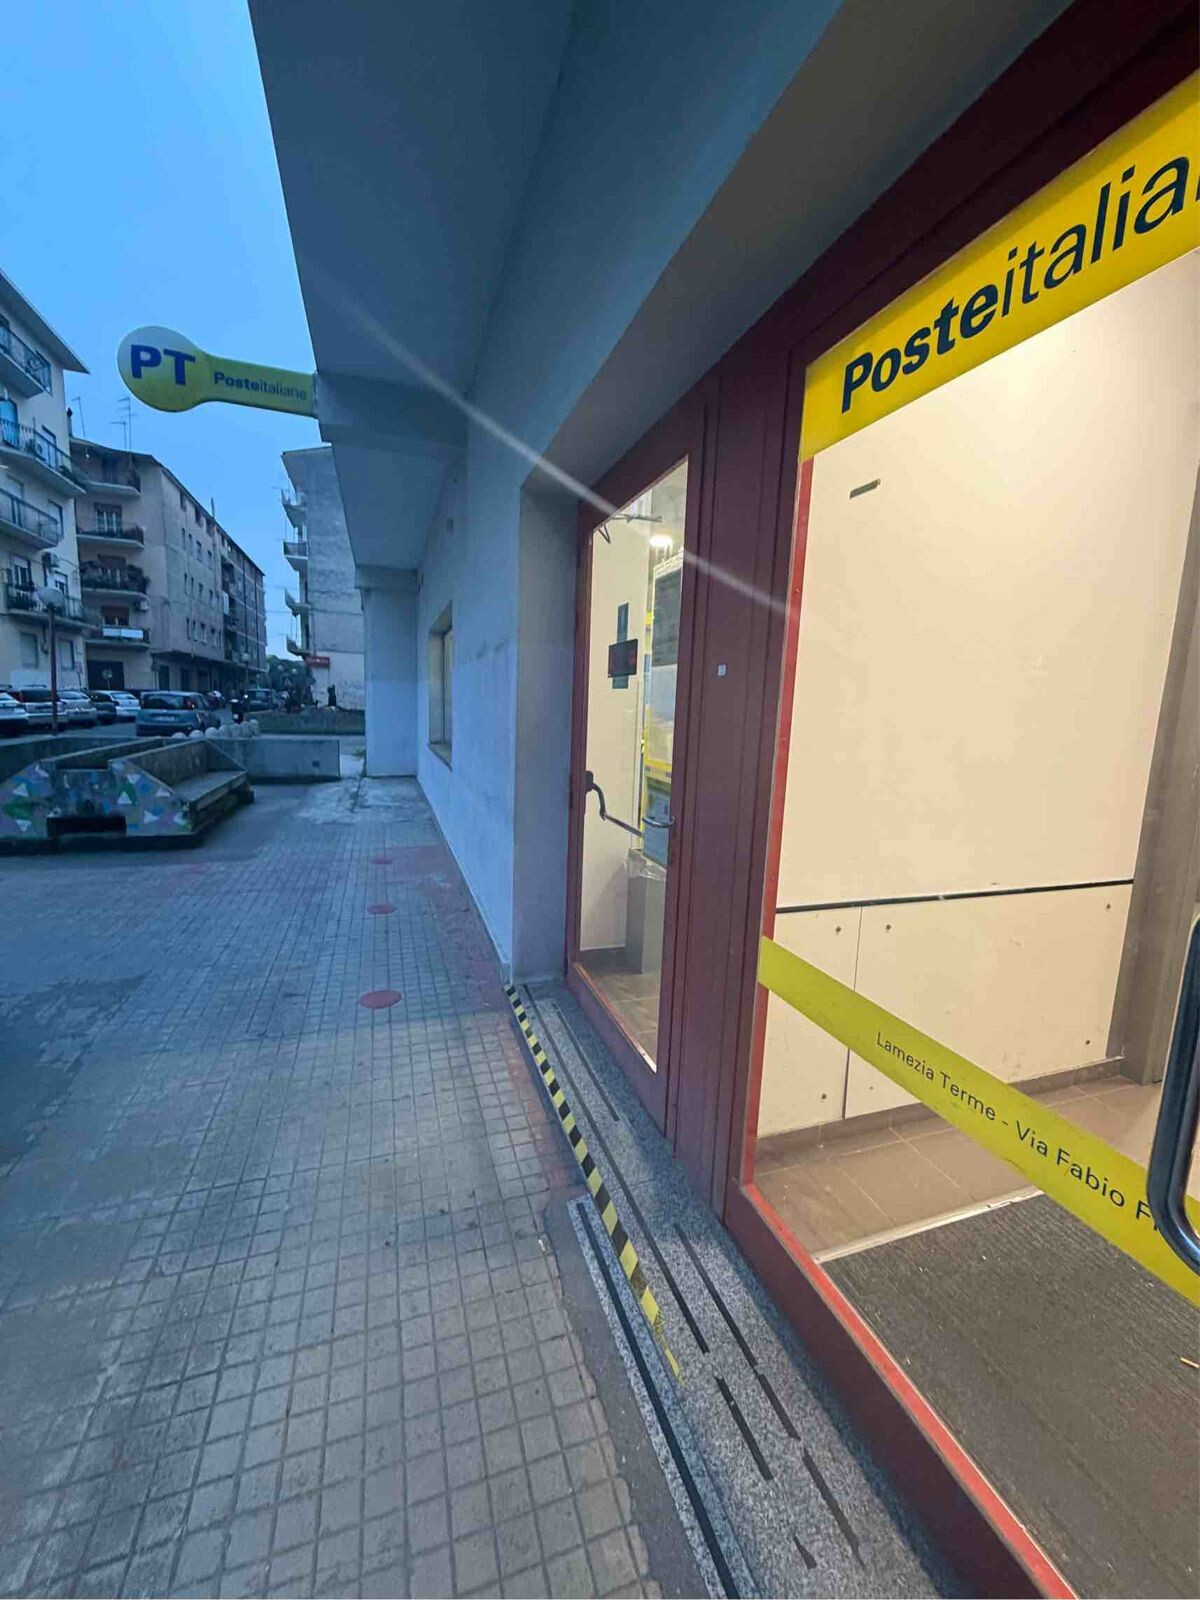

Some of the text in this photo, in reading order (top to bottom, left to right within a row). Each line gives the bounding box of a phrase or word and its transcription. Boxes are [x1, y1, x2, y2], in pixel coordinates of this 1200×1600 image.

[841, 156, 1200, 414] Posteitalia
[130, 344, 196, 386] PT
[213, 371, 308, 400] Posteitaliane
[876, 1031, 935, 1081] Lamezia
[940, 1071, 997, 1122] Terme
[1015, 1120, 1049, 1158] Via
[1056, 1147, 1125, 1208] Fabio
